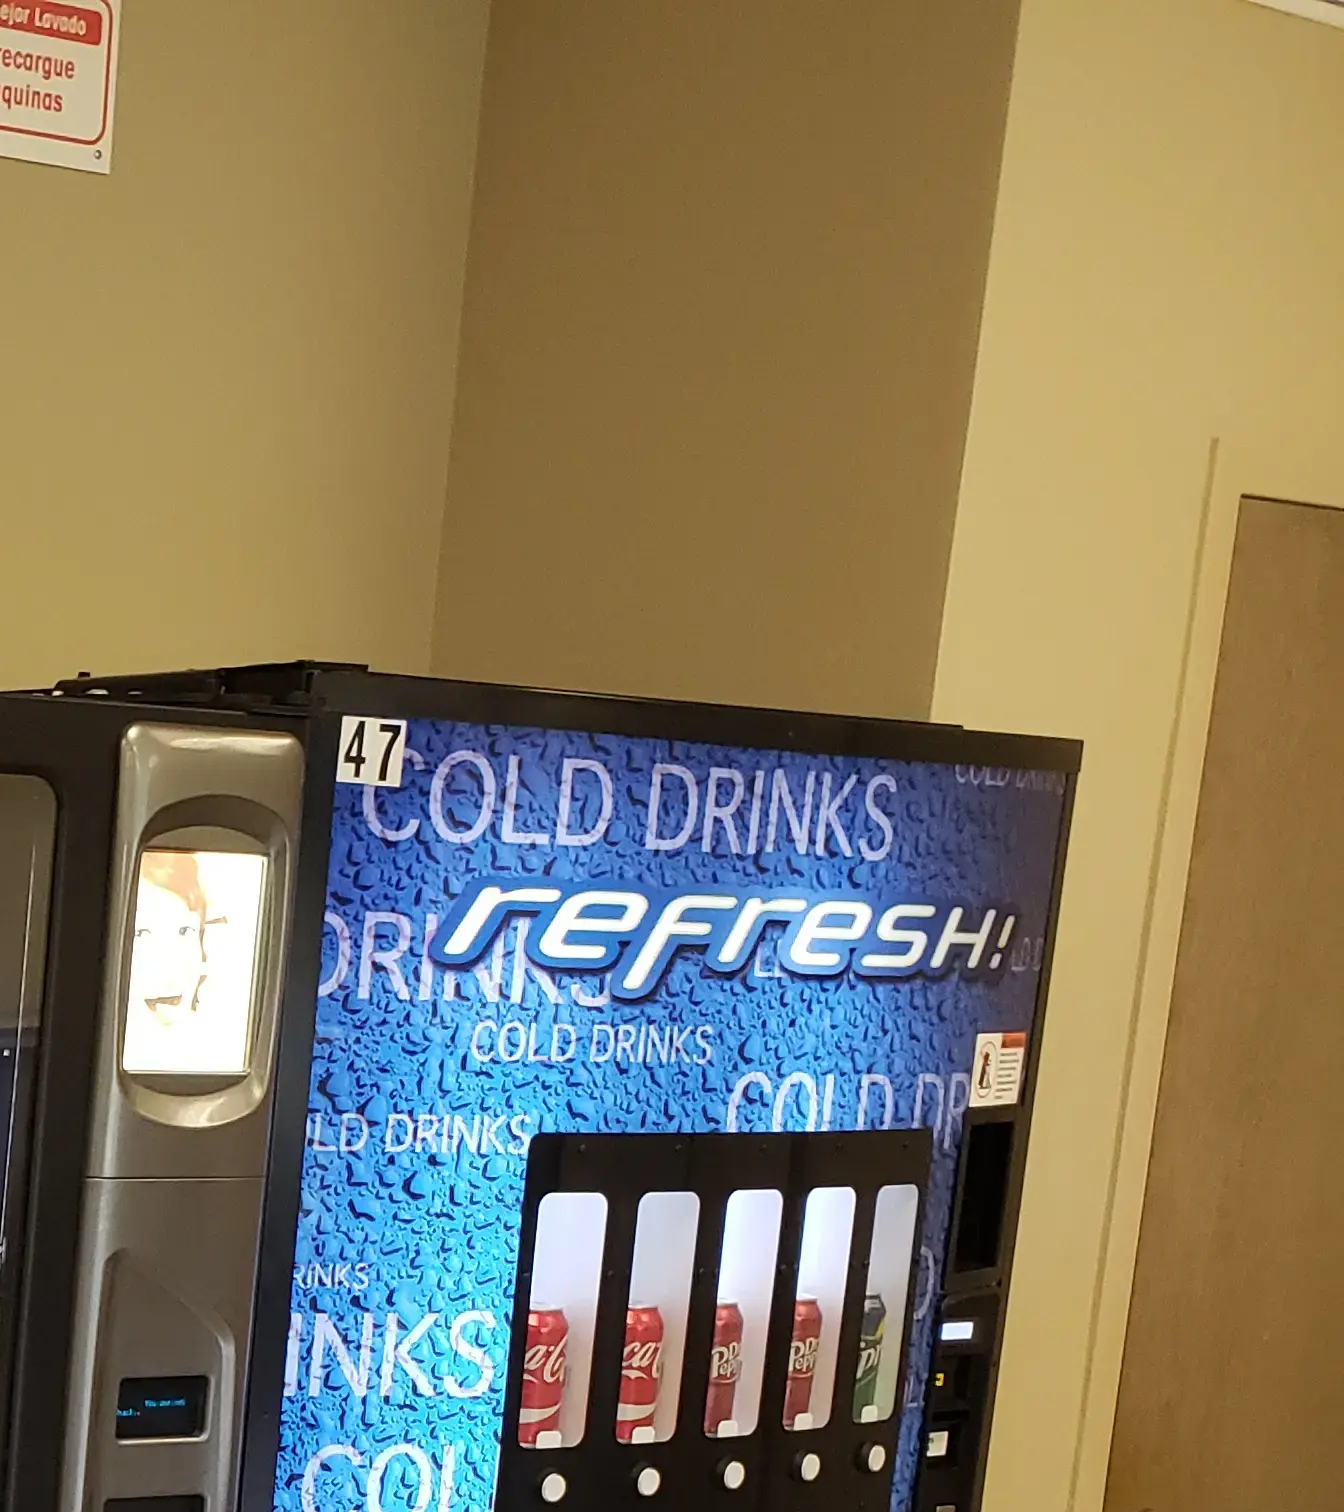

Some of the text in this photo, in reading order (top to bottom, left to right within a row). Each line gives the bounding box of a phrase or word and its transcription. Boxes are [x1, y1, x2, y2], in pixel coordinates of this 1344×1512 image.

[34, 8, 87, 36] Lavado
[343, 720, 403, 783] 47
[366, 750, 895, 862] COLD DRINKS
[471, 1020, 712, 1065] COLD DRINKS
[382, 1114, 531, 1155] DRINKS
